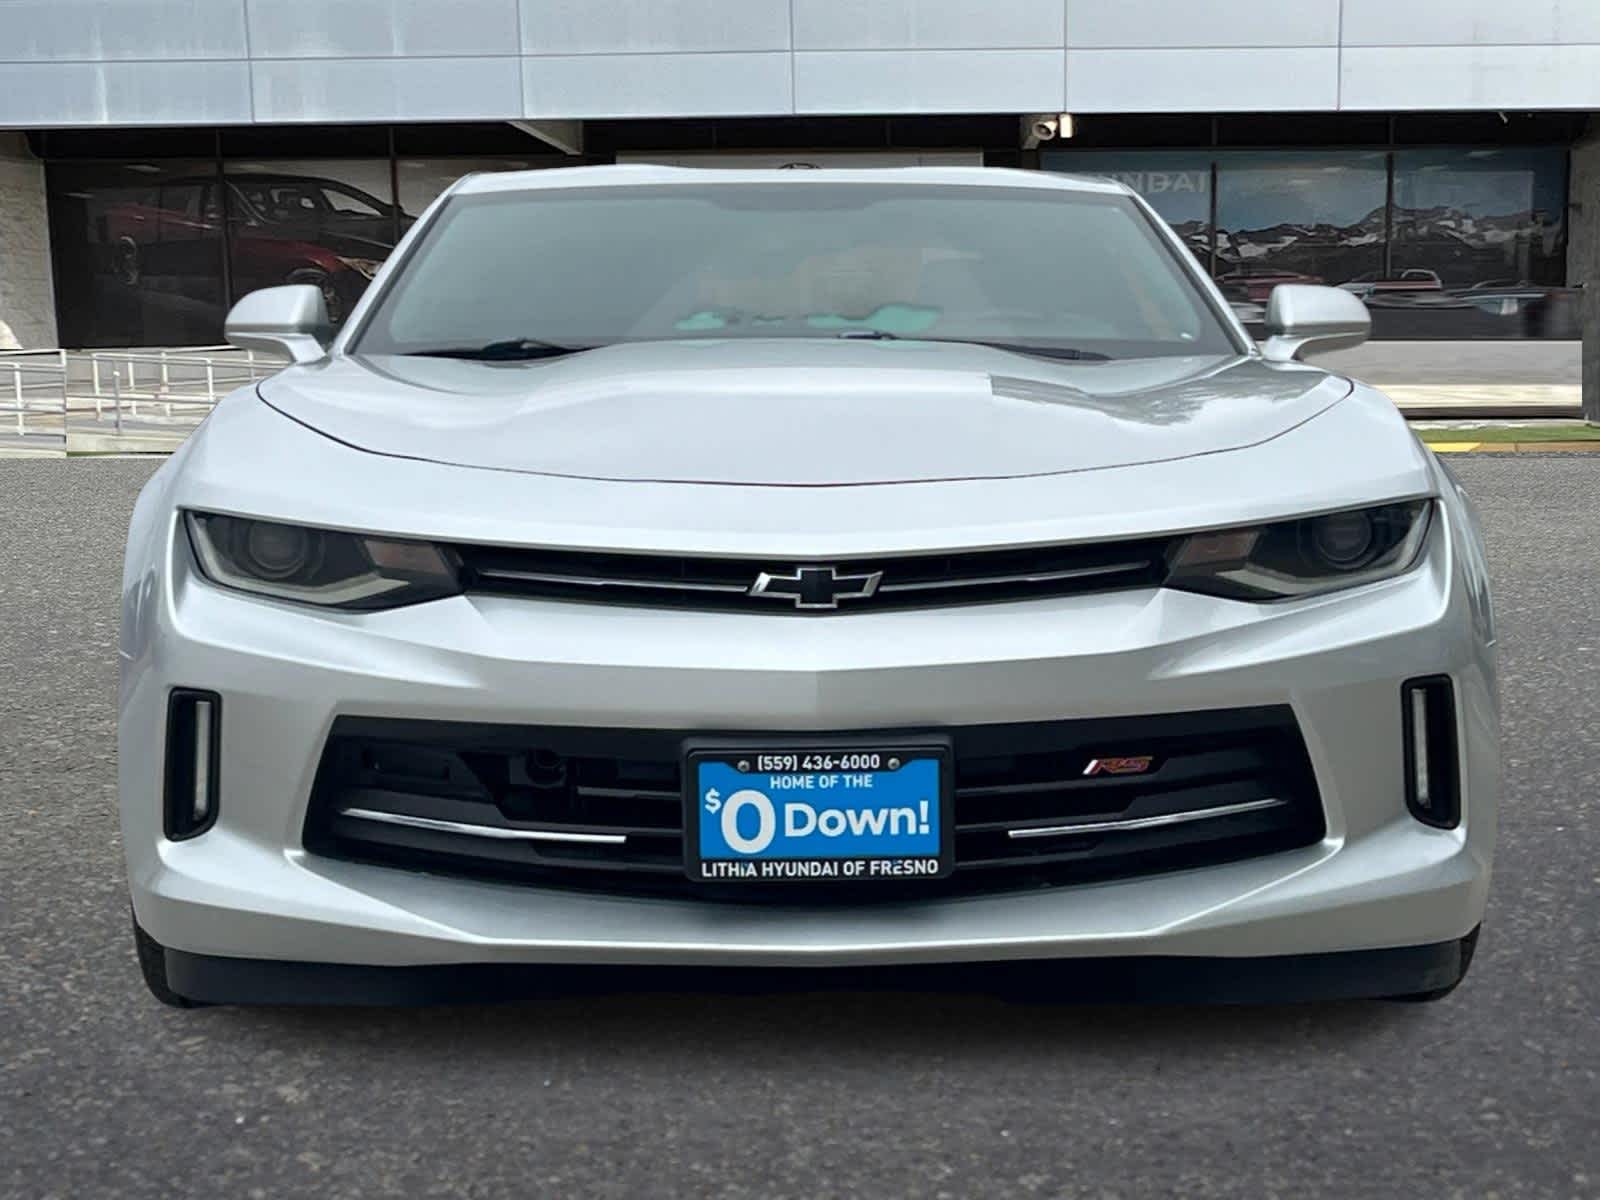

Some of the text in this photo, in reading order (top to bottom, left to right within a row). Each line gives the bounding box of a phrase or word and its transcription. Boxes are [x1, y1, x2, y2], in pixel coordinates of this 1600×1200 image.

[1104, 172, 1207, 193] NDAI
[757, 754, 881, 771] (559) 436-6000
[770, 774, 873, 789] HOME OF THE
[705, 788, 930, 854] $0 Down!
[702, 859, 939, 877] LITHIA HYUNDAI OF FRESNO
